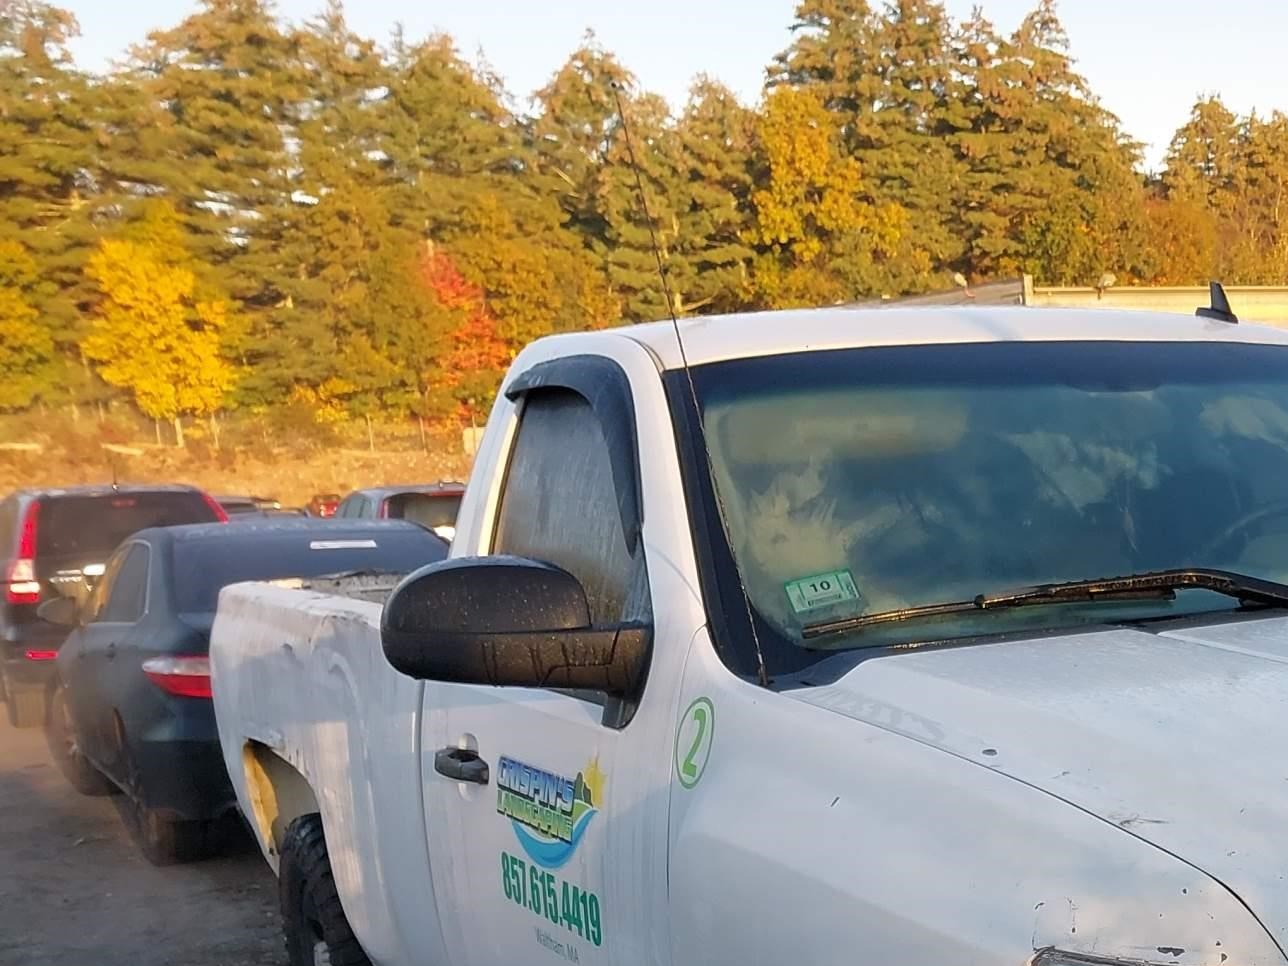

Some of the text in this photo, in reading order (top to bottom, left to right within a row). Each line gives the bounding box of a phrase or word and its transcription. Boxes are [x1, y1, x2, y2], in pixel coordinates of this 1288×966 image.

[809, 580, 832, 593] 10
[682, 707, 706, 778] 2
[496, 755, 575, 814] CRISPIN'S
[496, 790, 573, 844] LANDSCAPING
[501, 851, 602, 947] 857.615.4419
